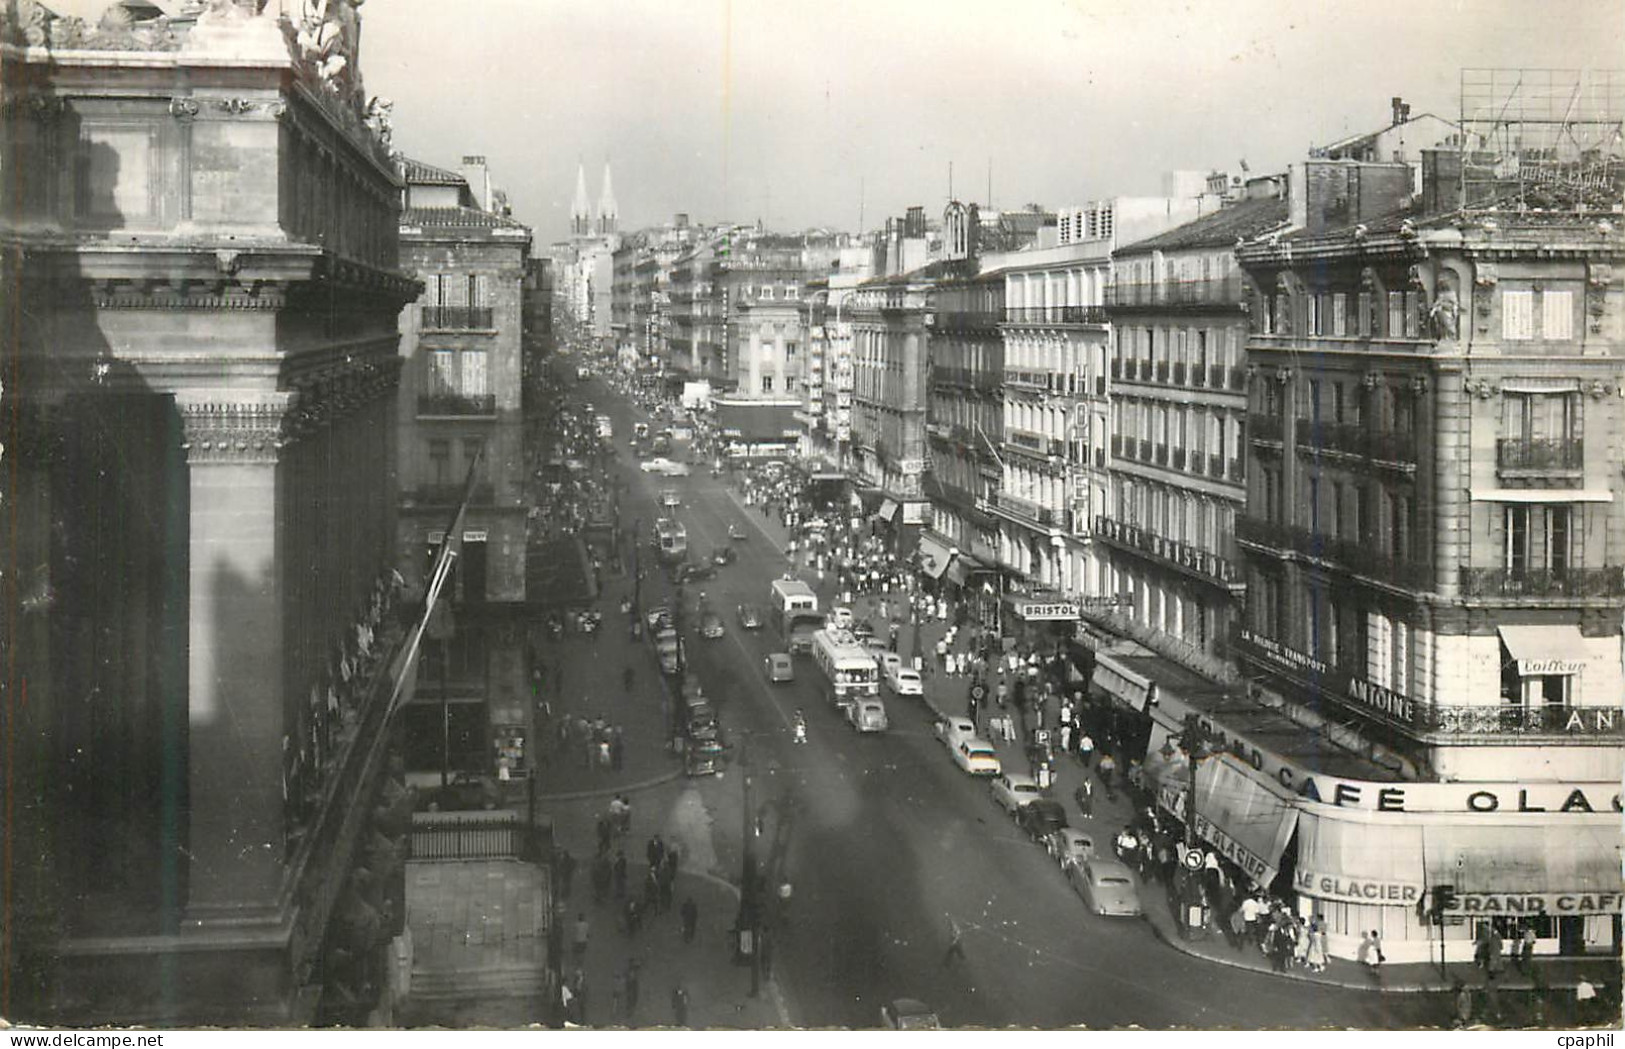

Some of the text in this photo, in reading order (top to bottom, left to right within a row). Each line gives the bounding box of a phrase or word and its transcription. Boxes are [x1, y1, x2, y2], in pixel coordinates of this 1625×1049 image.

[1073, 365, 1089, 536] HOTEL
[1097, 516, 1228, 581] HOTEL BRISTOL
[1026, 606, 1076, 615] BRISTOL
[1524, 659, 1587, 673] Coiffeur
[1350, 677, 1413, 722] ANTOINE
[1566, 710, 1613, 730] AN
[1039, 732, 1048, 743] P
[1279, 767, 1405, 812] CAFÉ
[1213, 830, 1266, 878] GLACIER
[1320, 877, 1417, 900] GLACIER
